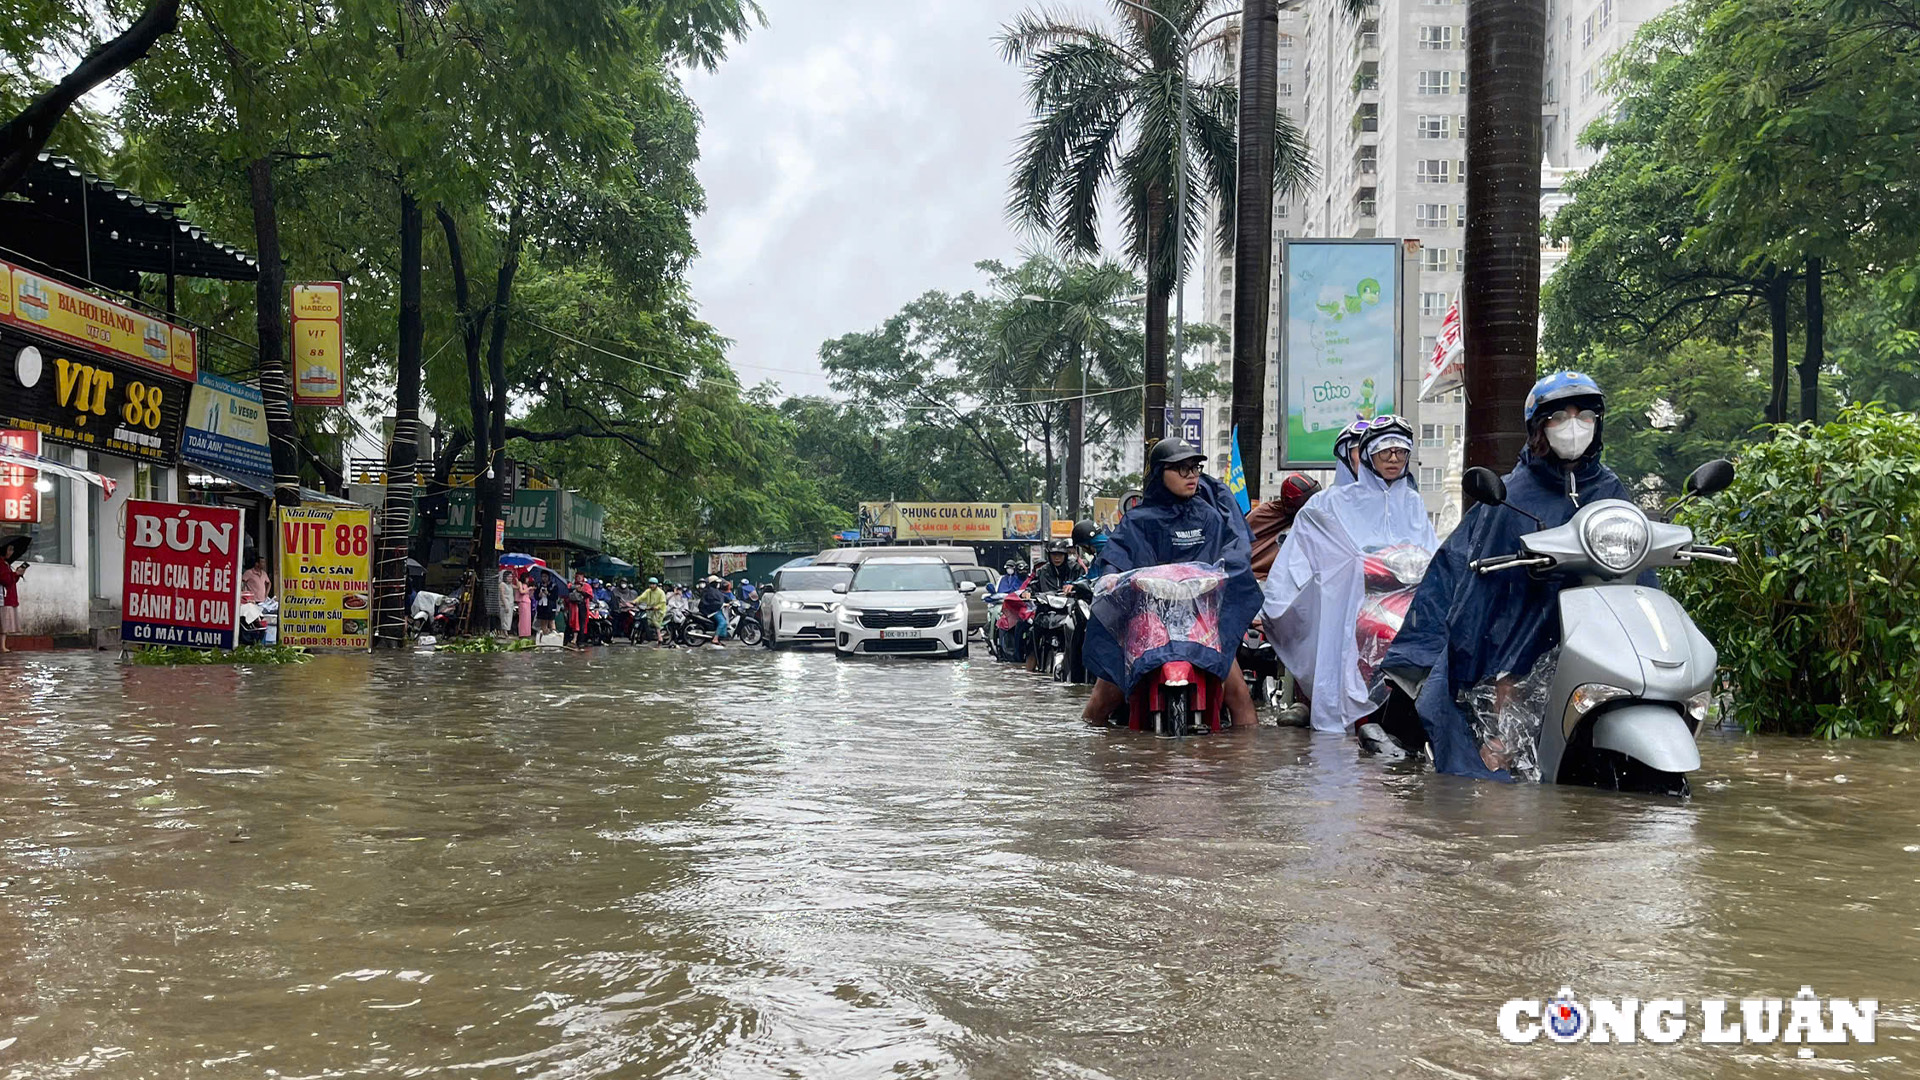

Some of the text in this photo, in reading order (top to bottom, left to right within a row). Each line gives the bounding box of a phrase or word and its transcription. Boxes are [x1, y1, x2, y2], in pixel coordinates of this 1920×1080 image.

[58, 293, 77, 314] BIA
[100, 307, 116, 328] HÀ
[116, 314, 135, 337] NỘI
[308, 330, 326, 338] VỊT
[55, 358, 114, 426] VỊT
[122, 381, 163, 430] 88
[238, 405, 258, 420] VESBO
[1167, 425, 1200, 440] HTEL
[207, 440, 223, 452] ANH
[506, 497, 549, 528] HUẾ
[902, 506, 997, 521] PHỤNG CUA CÀ MAU
[133, 509, 234, 555] BÚN
[283, 522, 368, 562] VỊT 88
[130, 556, 160, 587] RIÊU
[164, 563, 190, 589] CUA
[329, 565, 354, 575] SẢN
[343, 579, 368, 591] ĐÌNH
[129, 588, 230, 625] BÁNH ĐA CUA
[313, 611, 325, 619] OM
[134, 624, 222, 646] CÓ MÁY LẠNH
[283, 636, 297, 645] ĐT:
